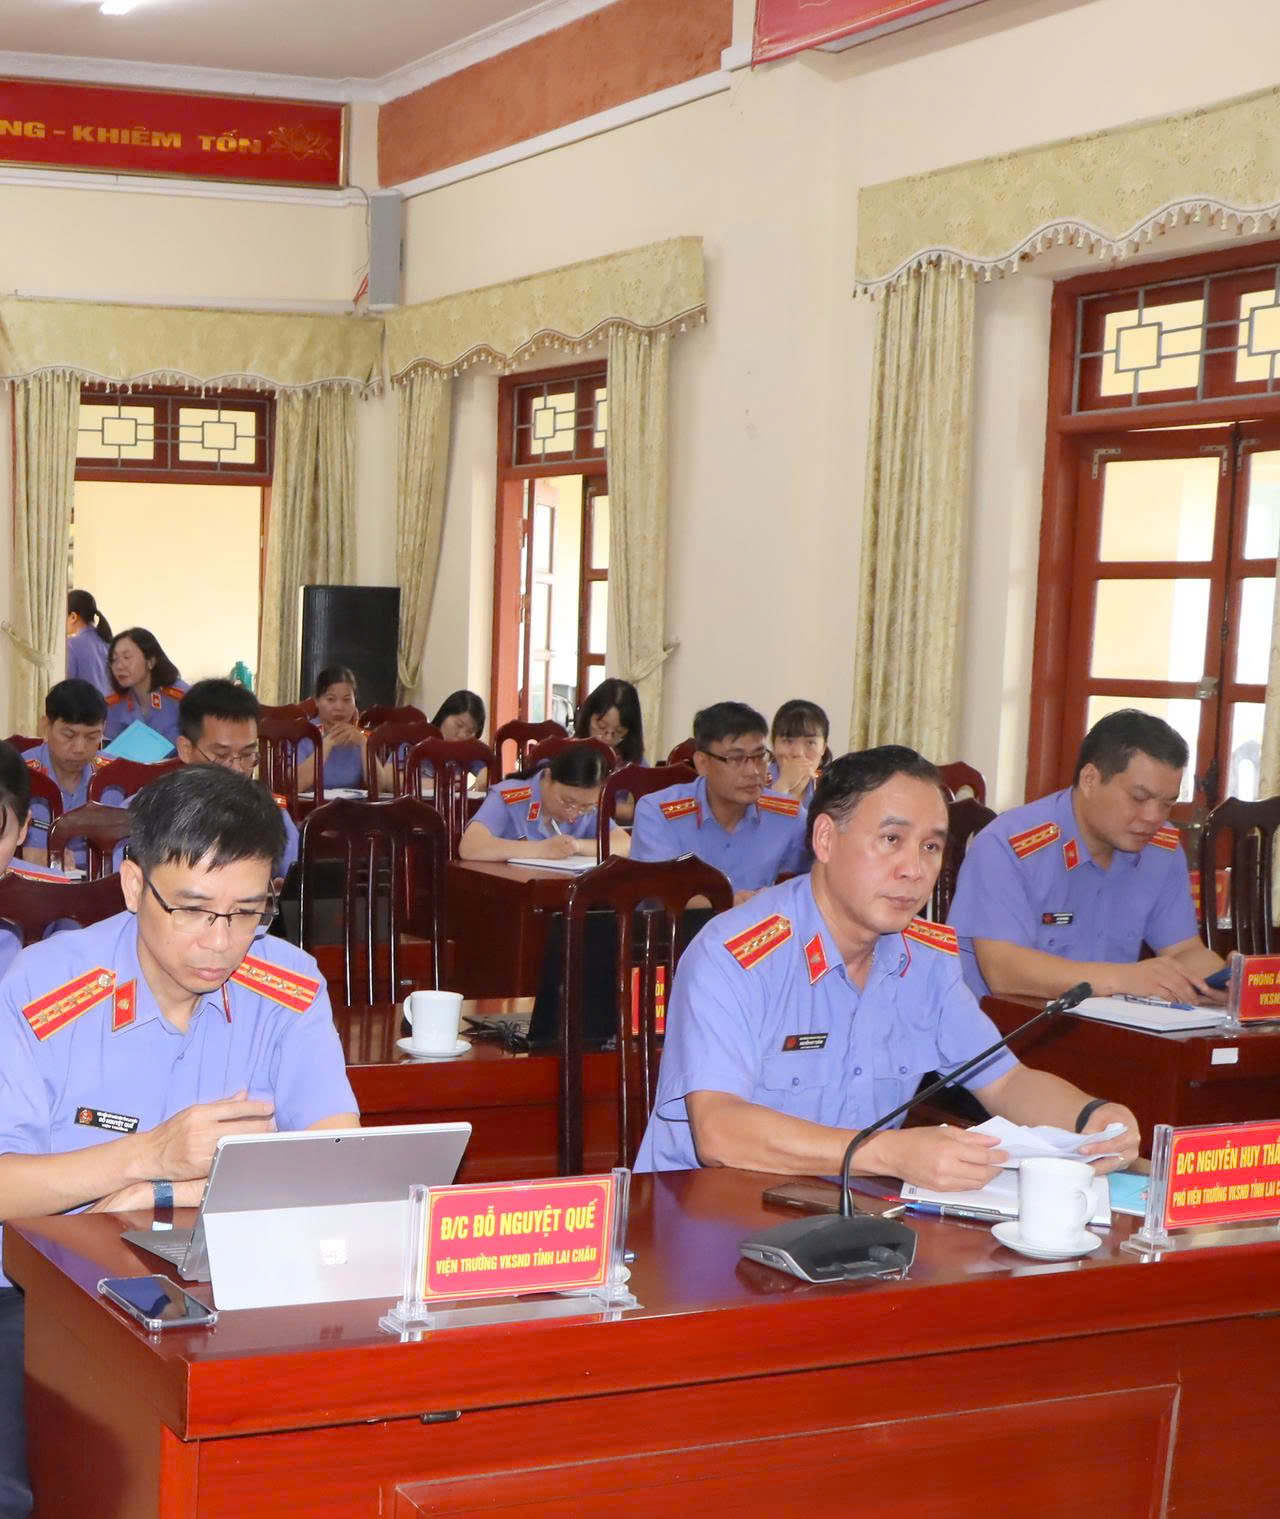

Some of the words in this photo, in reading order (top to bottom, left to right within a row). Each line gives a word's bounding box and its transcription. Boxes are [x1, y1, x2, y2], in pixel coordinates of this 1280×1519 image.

[72, 124, 182, 149] KHIÊM
[199, 128, 262, 154] TỐN
[1176, 1151, 1195, 1176] Đ/C
[1196, 1140, 1239, 1173] NGUYỄN
[1240, 1144, 1261, 1168] HUY
[440, 1215, 469, 1241] Đ/C
[473, 1205, 496, 1239] ĐỖ
[499, 1204, 562, 1237] NGUYỆT
[565, 1198, 599, 1233] QUẾ
[436, 1254, 458, 1277] VIỆN
[500, 1253, 531, 1270] VKSND
[533, 1247, 554, 1266] TỈNH
[555, 1249, 571, 1265] LAI
[572, 1247, 597, 1264] CHÂU
